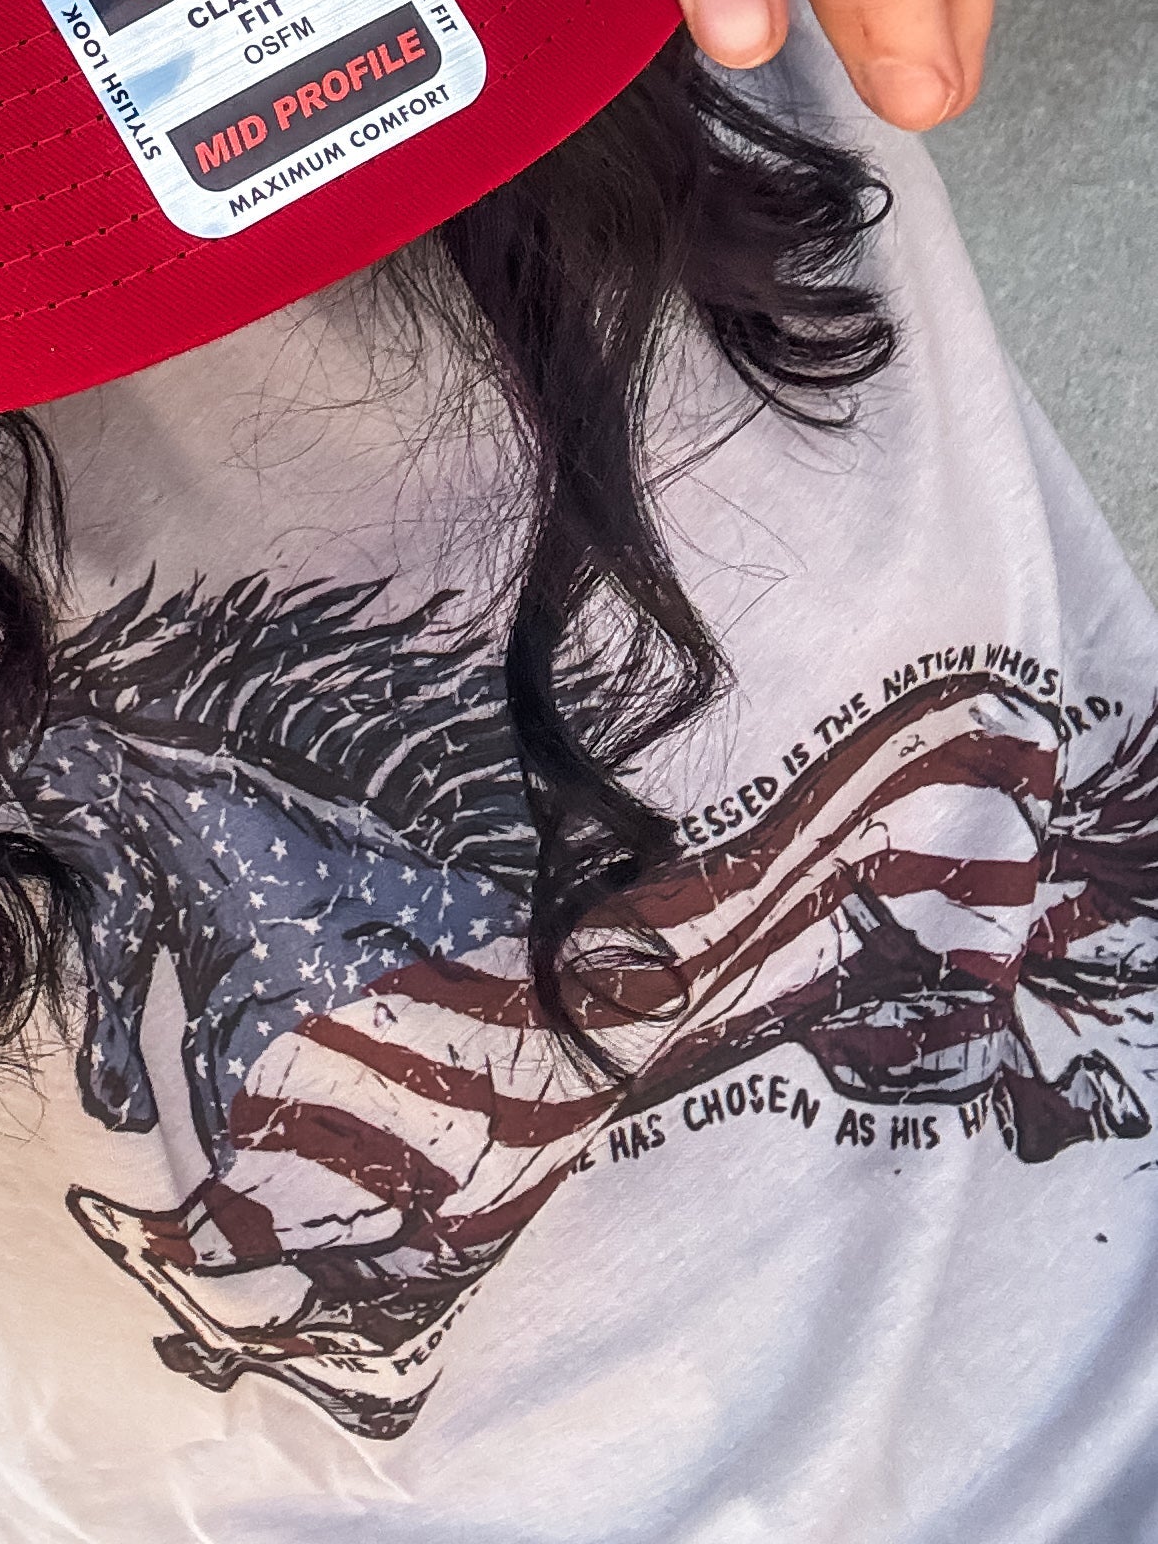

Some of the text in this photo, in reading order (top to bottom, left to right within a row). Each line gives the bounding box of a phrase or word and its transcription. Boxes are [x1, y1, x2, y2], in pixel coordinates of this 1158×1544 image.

[60, 2, 162, 161] STYLISH LOOK
[243, 16, 316, 64] OSFM
[430, 3, 458, 33] FIT
[194, 27, 426, 174] MID PROFILE
[228, 84, 452, 217] MAXIMUM COMFORT
[681, 776, 779, 844] ESSED
[781, 742, 811, 776] IS
[813, 692, 871, 745] THE
[882, 643, 976, 704] NATION
[984, 643, 1059, 696] WHOS
[609, 1113, 666, 1163] HAS
[683, 1073, 821, 1133] CHOSEN
[835, 1108, 876, 1147] AS
[890, 1115, 941, 1150] HIS
